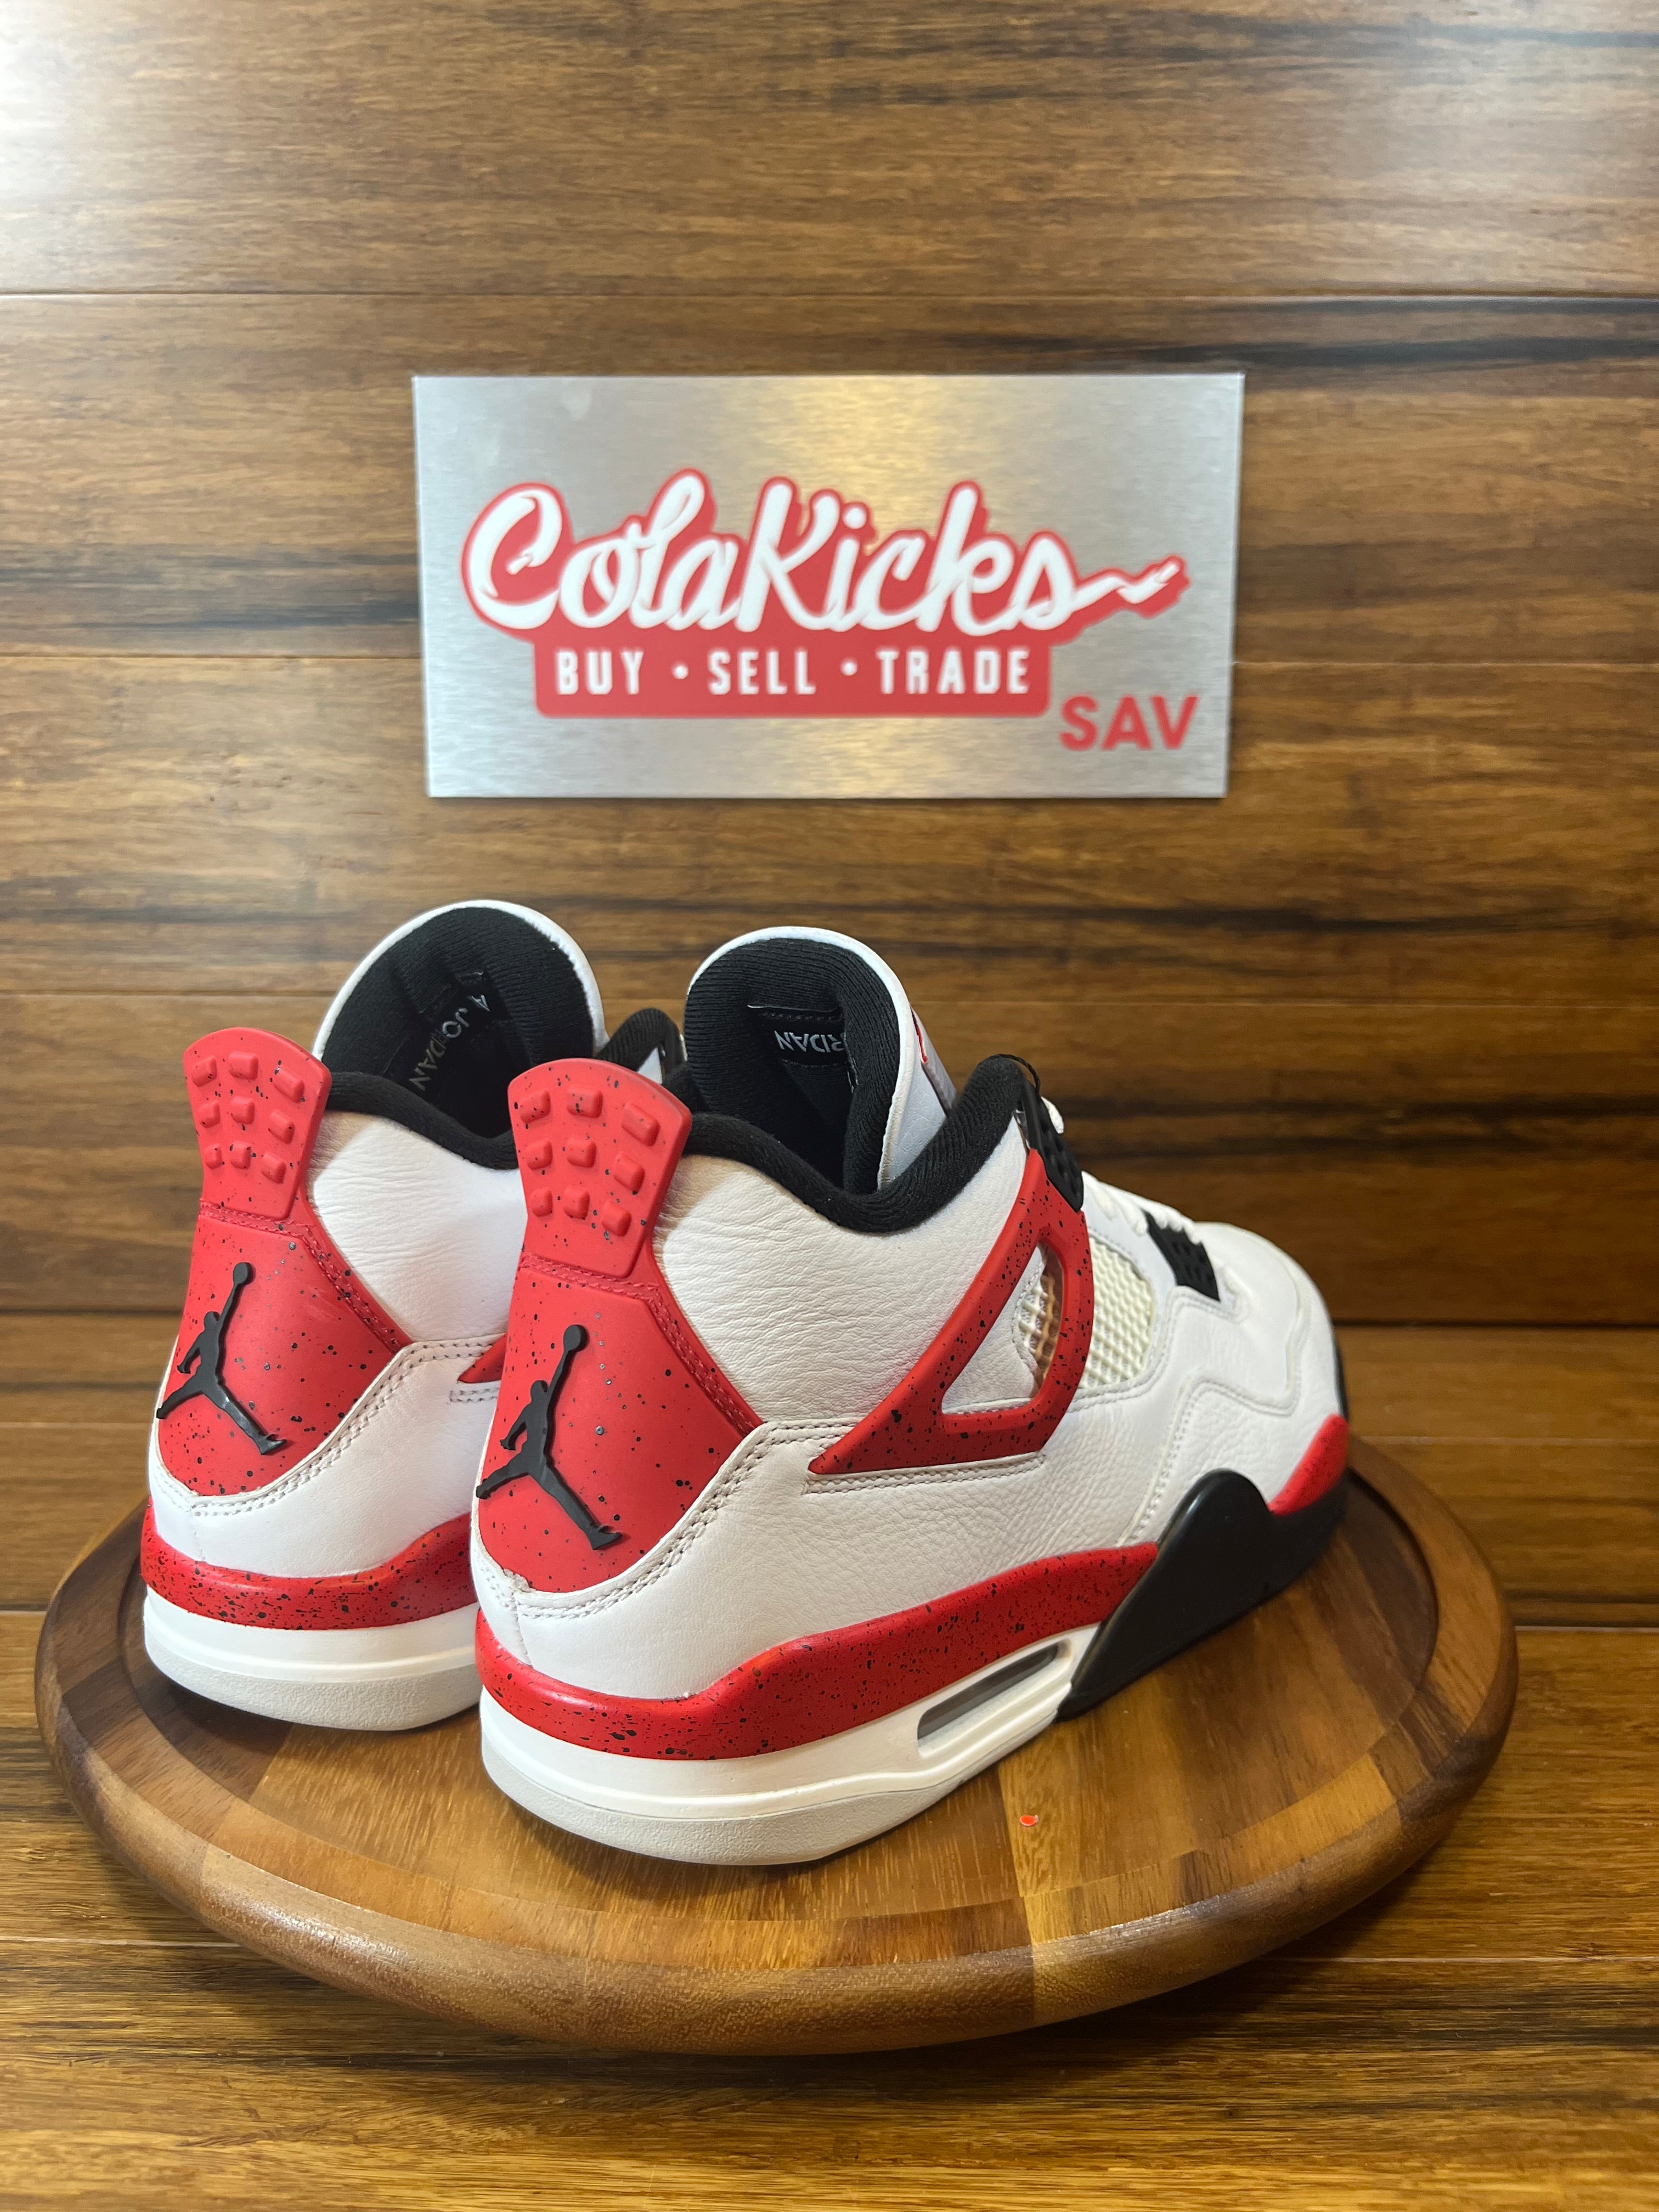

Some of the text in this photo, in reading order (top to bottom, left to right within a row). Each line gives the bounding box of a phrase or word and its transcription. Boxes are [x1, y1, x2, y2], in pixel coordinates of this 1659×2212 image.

[469, 475, 1180, 636] ColaKicks
[556, 647, 1030, 696] BUY SELL TRADE
[1059, 695, 1199, 751] SAV
[774, 1030, 845, 1053] RDAN
